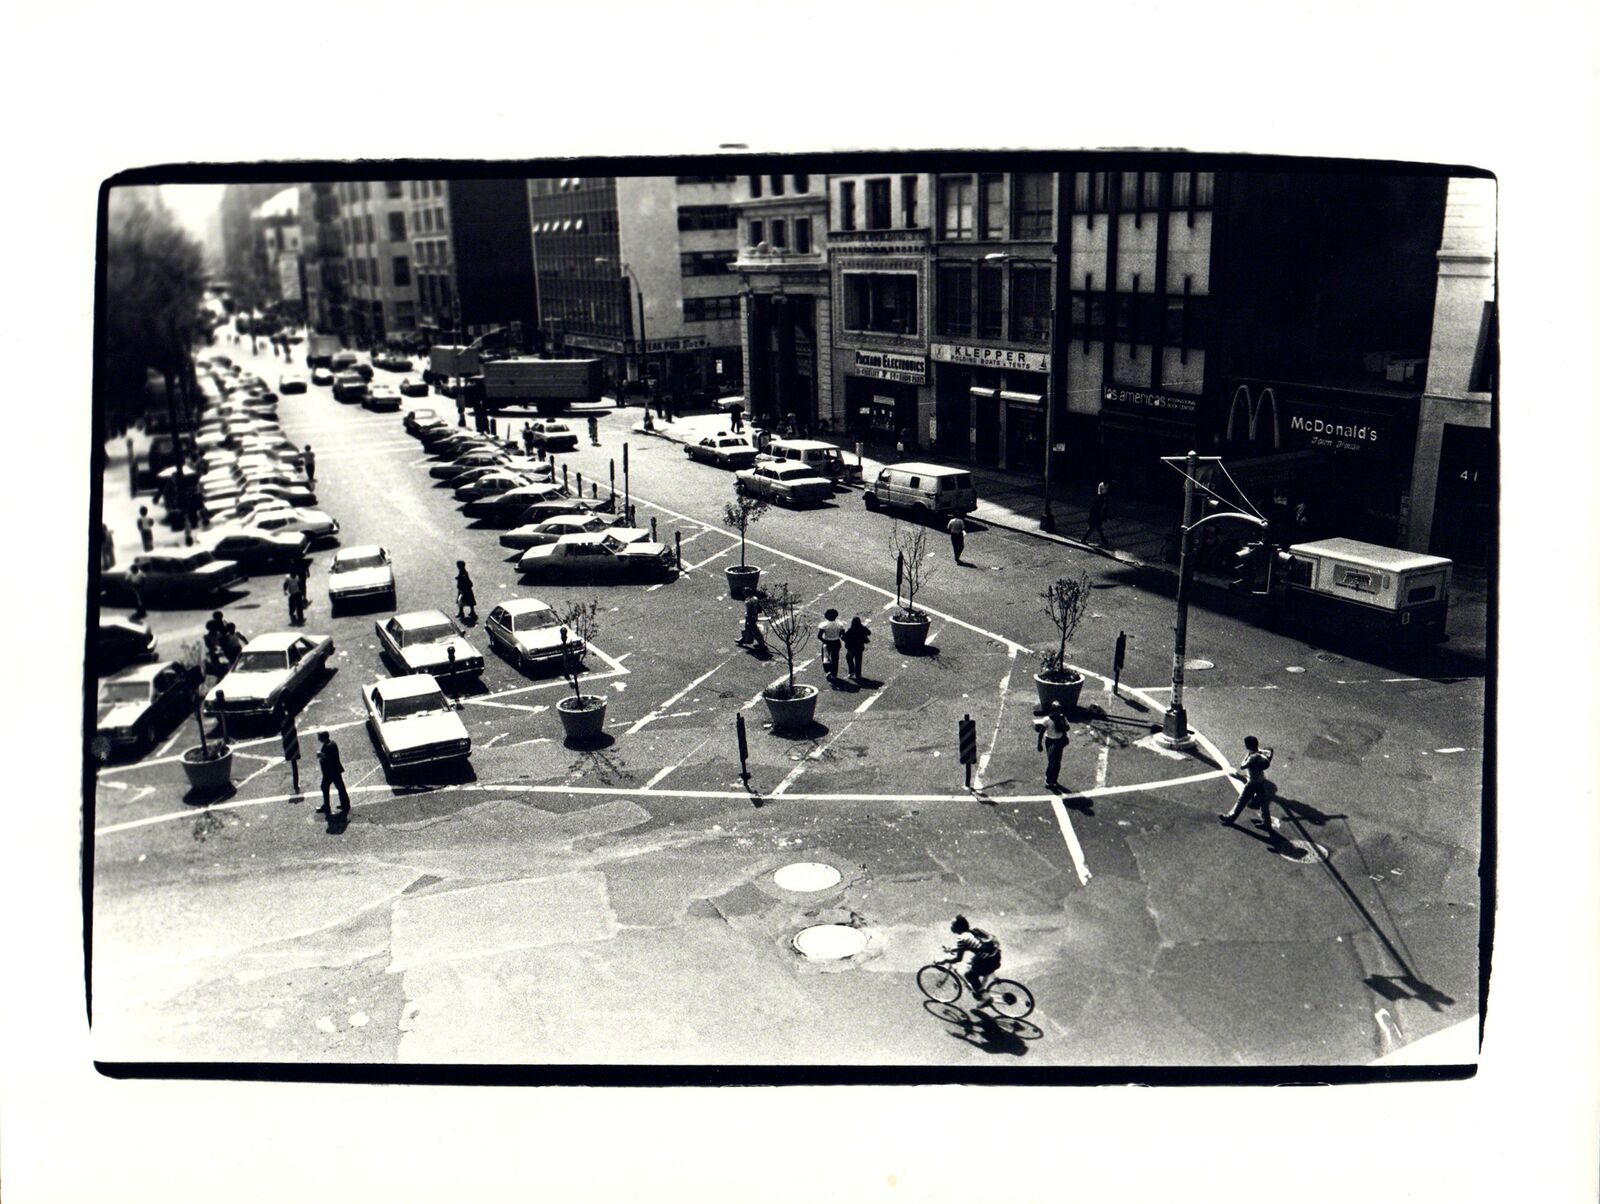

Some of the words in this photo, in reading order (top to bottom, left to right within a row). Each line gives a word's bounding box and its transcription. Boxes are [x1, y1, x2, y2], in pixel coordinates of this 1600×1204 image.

[955, 346, 1026, 362] KLEPPER
[980, 358, 1001, 367] BOATS
[1008, 361, 1031, 369] TENTS
[1103, 385, 1118, 401] las
[1119, 390, 1167, 408] americas
[1290, 416, 1378, 442] McDonald's
[1311, 436, 1333, 447] Town
[1335, 440, 1361, 452] House
